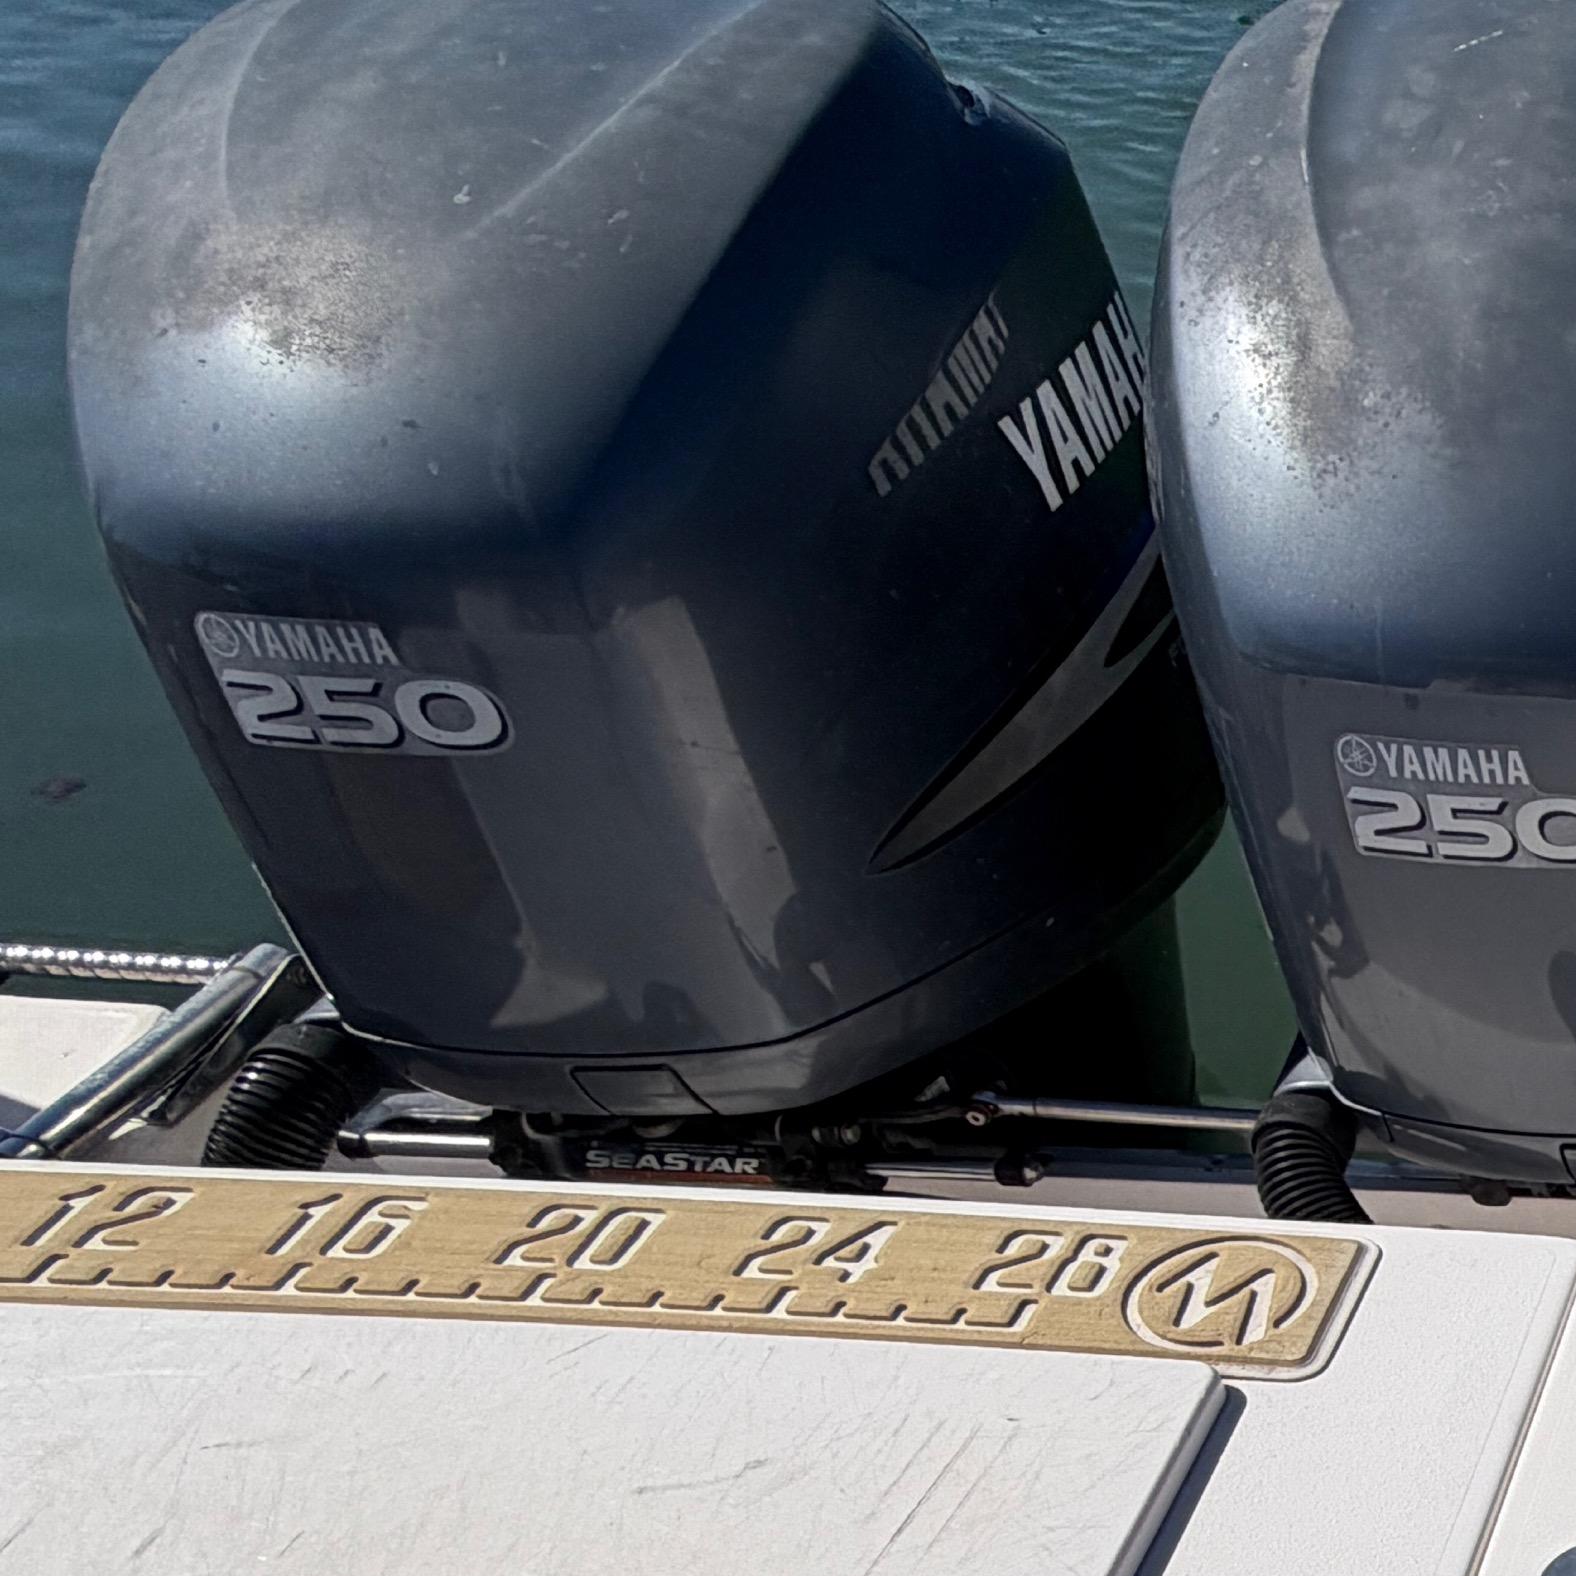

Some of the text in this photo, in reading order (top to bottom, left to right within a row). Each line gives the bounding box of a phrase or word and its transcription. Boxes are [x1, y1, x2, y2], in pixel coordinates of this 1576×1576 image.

[997, 290, 1147, 512] YAMAH
[235, 618, 400, 666] YAMAHA
[222, 668, 510, 751] 250
[1377, 741, 1531, 786] YAMAHA
[19, 1184, 1130, 1297] 12 16 20 24 28
